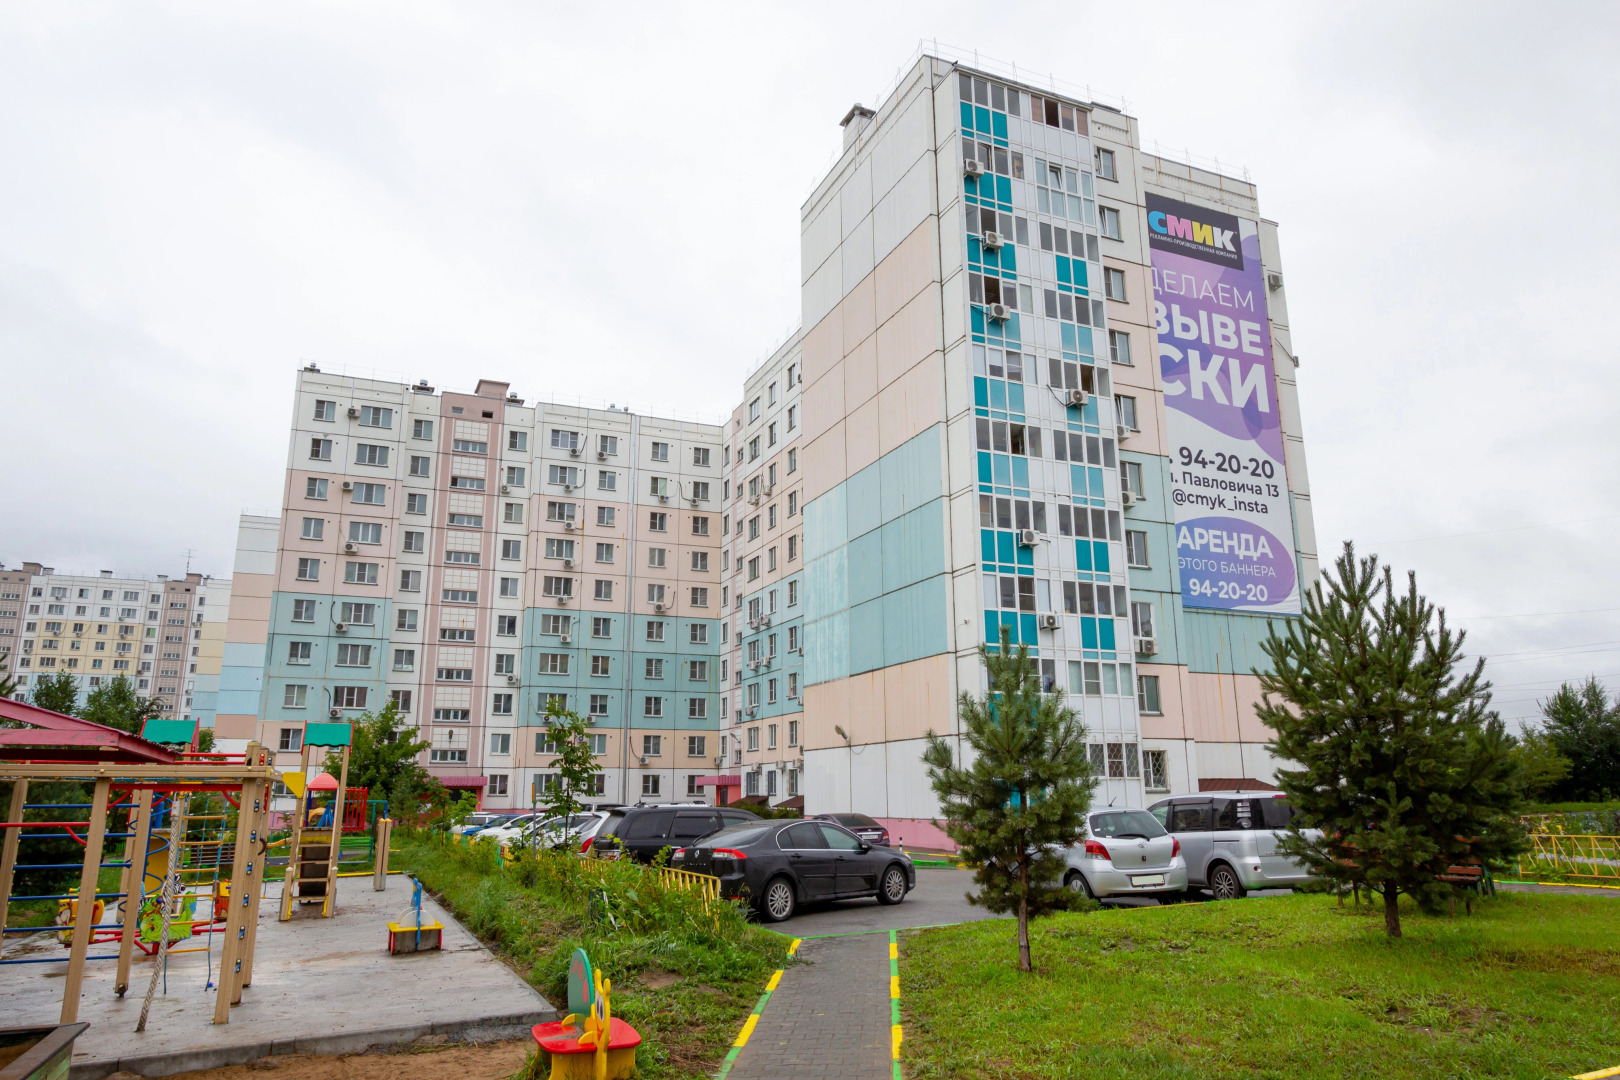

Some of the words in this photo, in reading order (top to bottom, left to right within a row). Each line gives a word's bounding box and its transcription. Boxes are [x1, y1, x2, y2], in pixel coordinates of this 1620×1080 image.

[1148, 210, 1237, 252] СМИК
[1154, 300, 1264, 356] ВЫВЕ
[1158, 342, 1270, 413] СКИ
[1179, 446, 1274, 479] 94-20-20
[1172, 488, 1268, 514] @cmyk_insta
[1182, 471, 1263, 496] Павловича
[1266, 483, 1280, 498] 13
[1177, 525, 1274, 561] АРЕНДА
[1178, 557, 1217, 572] ЭТОГО
[1220, 561, 1276, 578] БАННЕРА
[1189, 578, 1268, 602] 94-20-20
